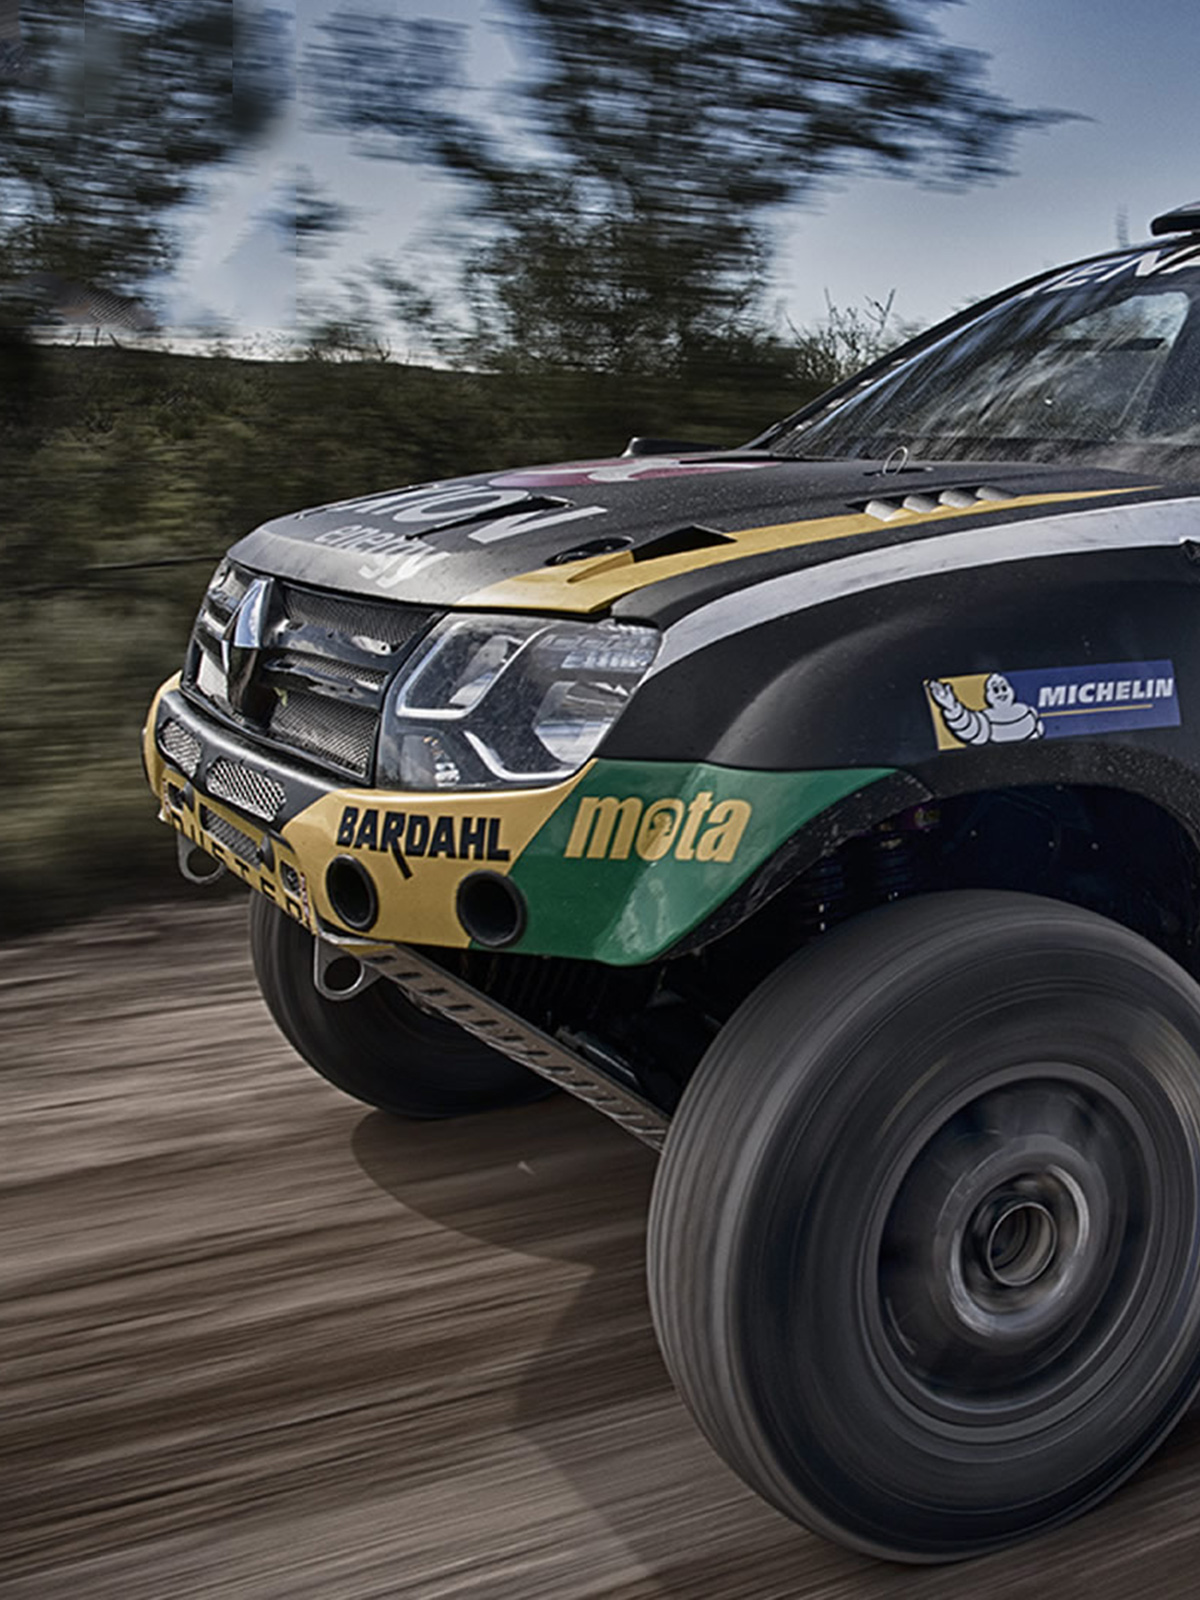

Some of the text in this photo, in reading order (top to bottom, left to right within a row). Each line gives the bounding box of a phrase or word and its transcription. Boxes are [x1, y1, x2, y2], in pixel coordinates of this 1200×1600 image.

[1038, 678, 1173, 707] MICHELIN
[336, 806, 510, 880] BARDAHL
[564, 796, 752, 863] mota
